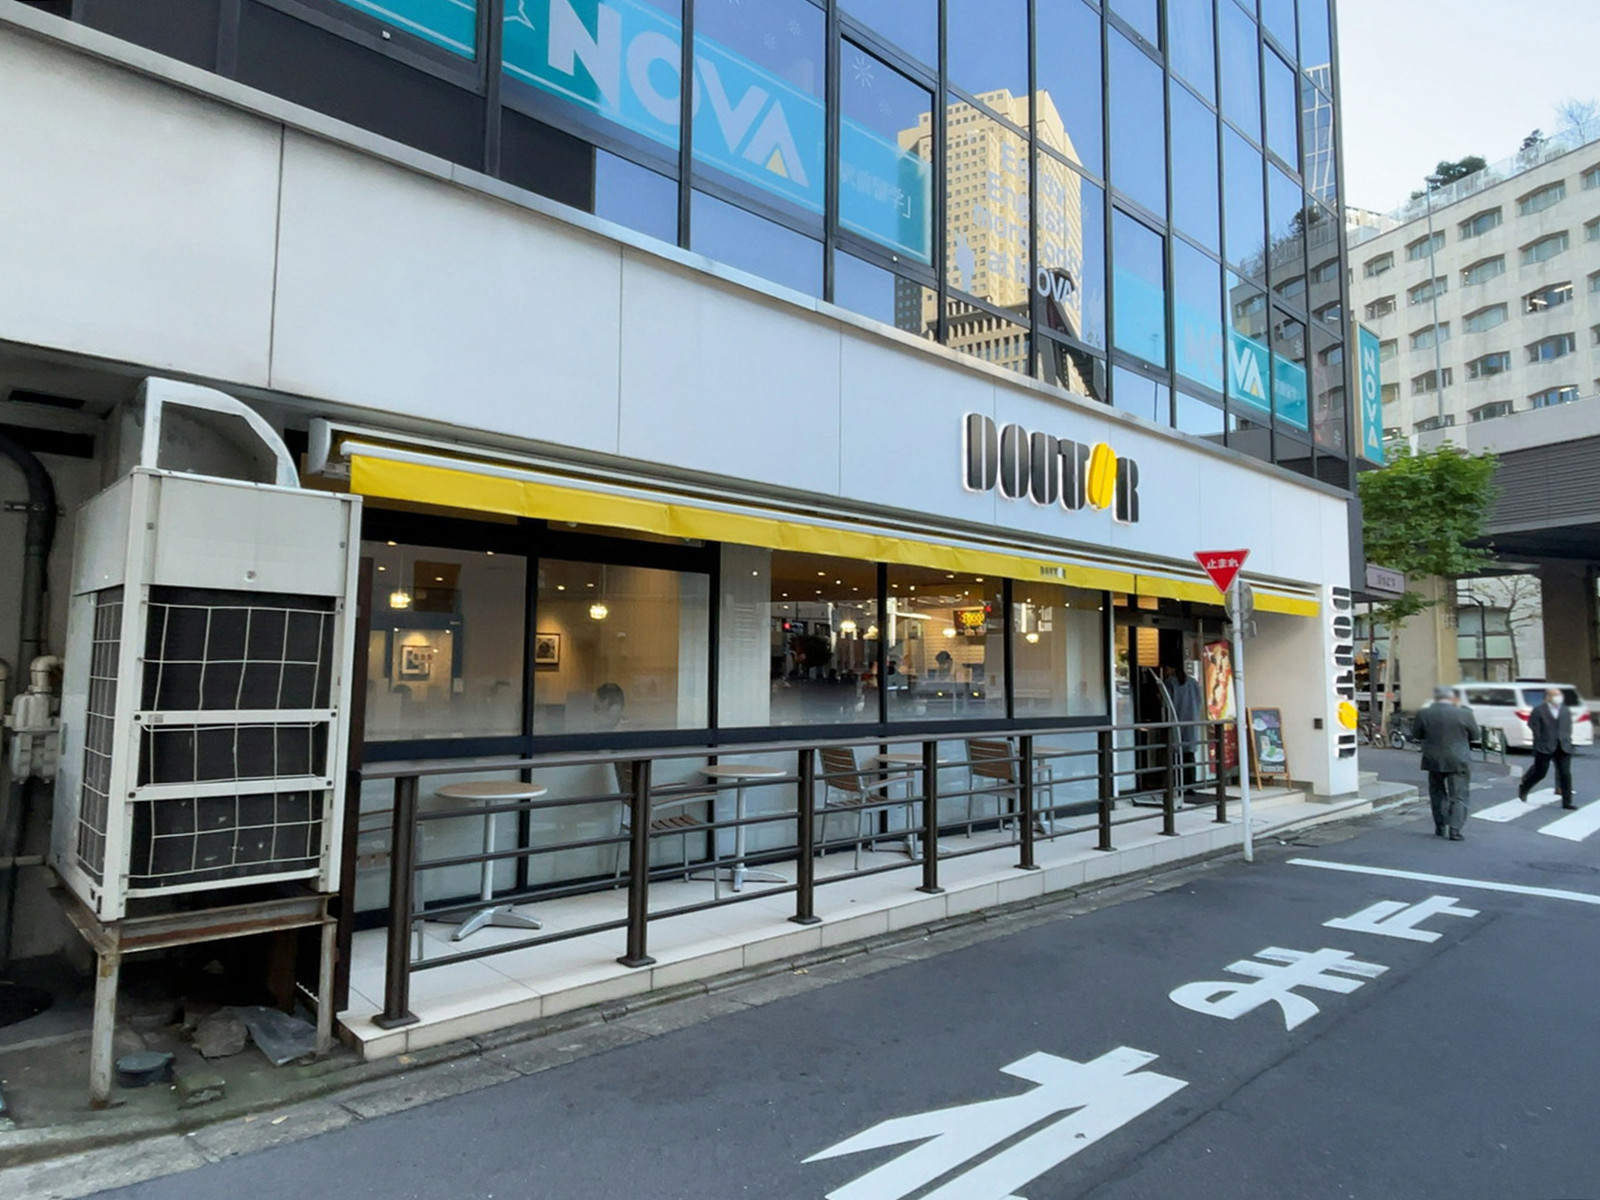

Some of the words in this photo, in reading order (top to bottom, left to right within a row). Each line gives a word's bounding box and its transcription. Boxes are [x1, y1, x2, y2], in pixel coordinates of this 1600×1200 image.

[547, 0, 810, 188] NOVA
[1363, 346, 1380, 450] NOVA
[964, 412, 1140, 524] DOUTOR
[1206, 558, 1240, 570] 止まれ
[1331, 586, 1358, 759] DOUTOR
